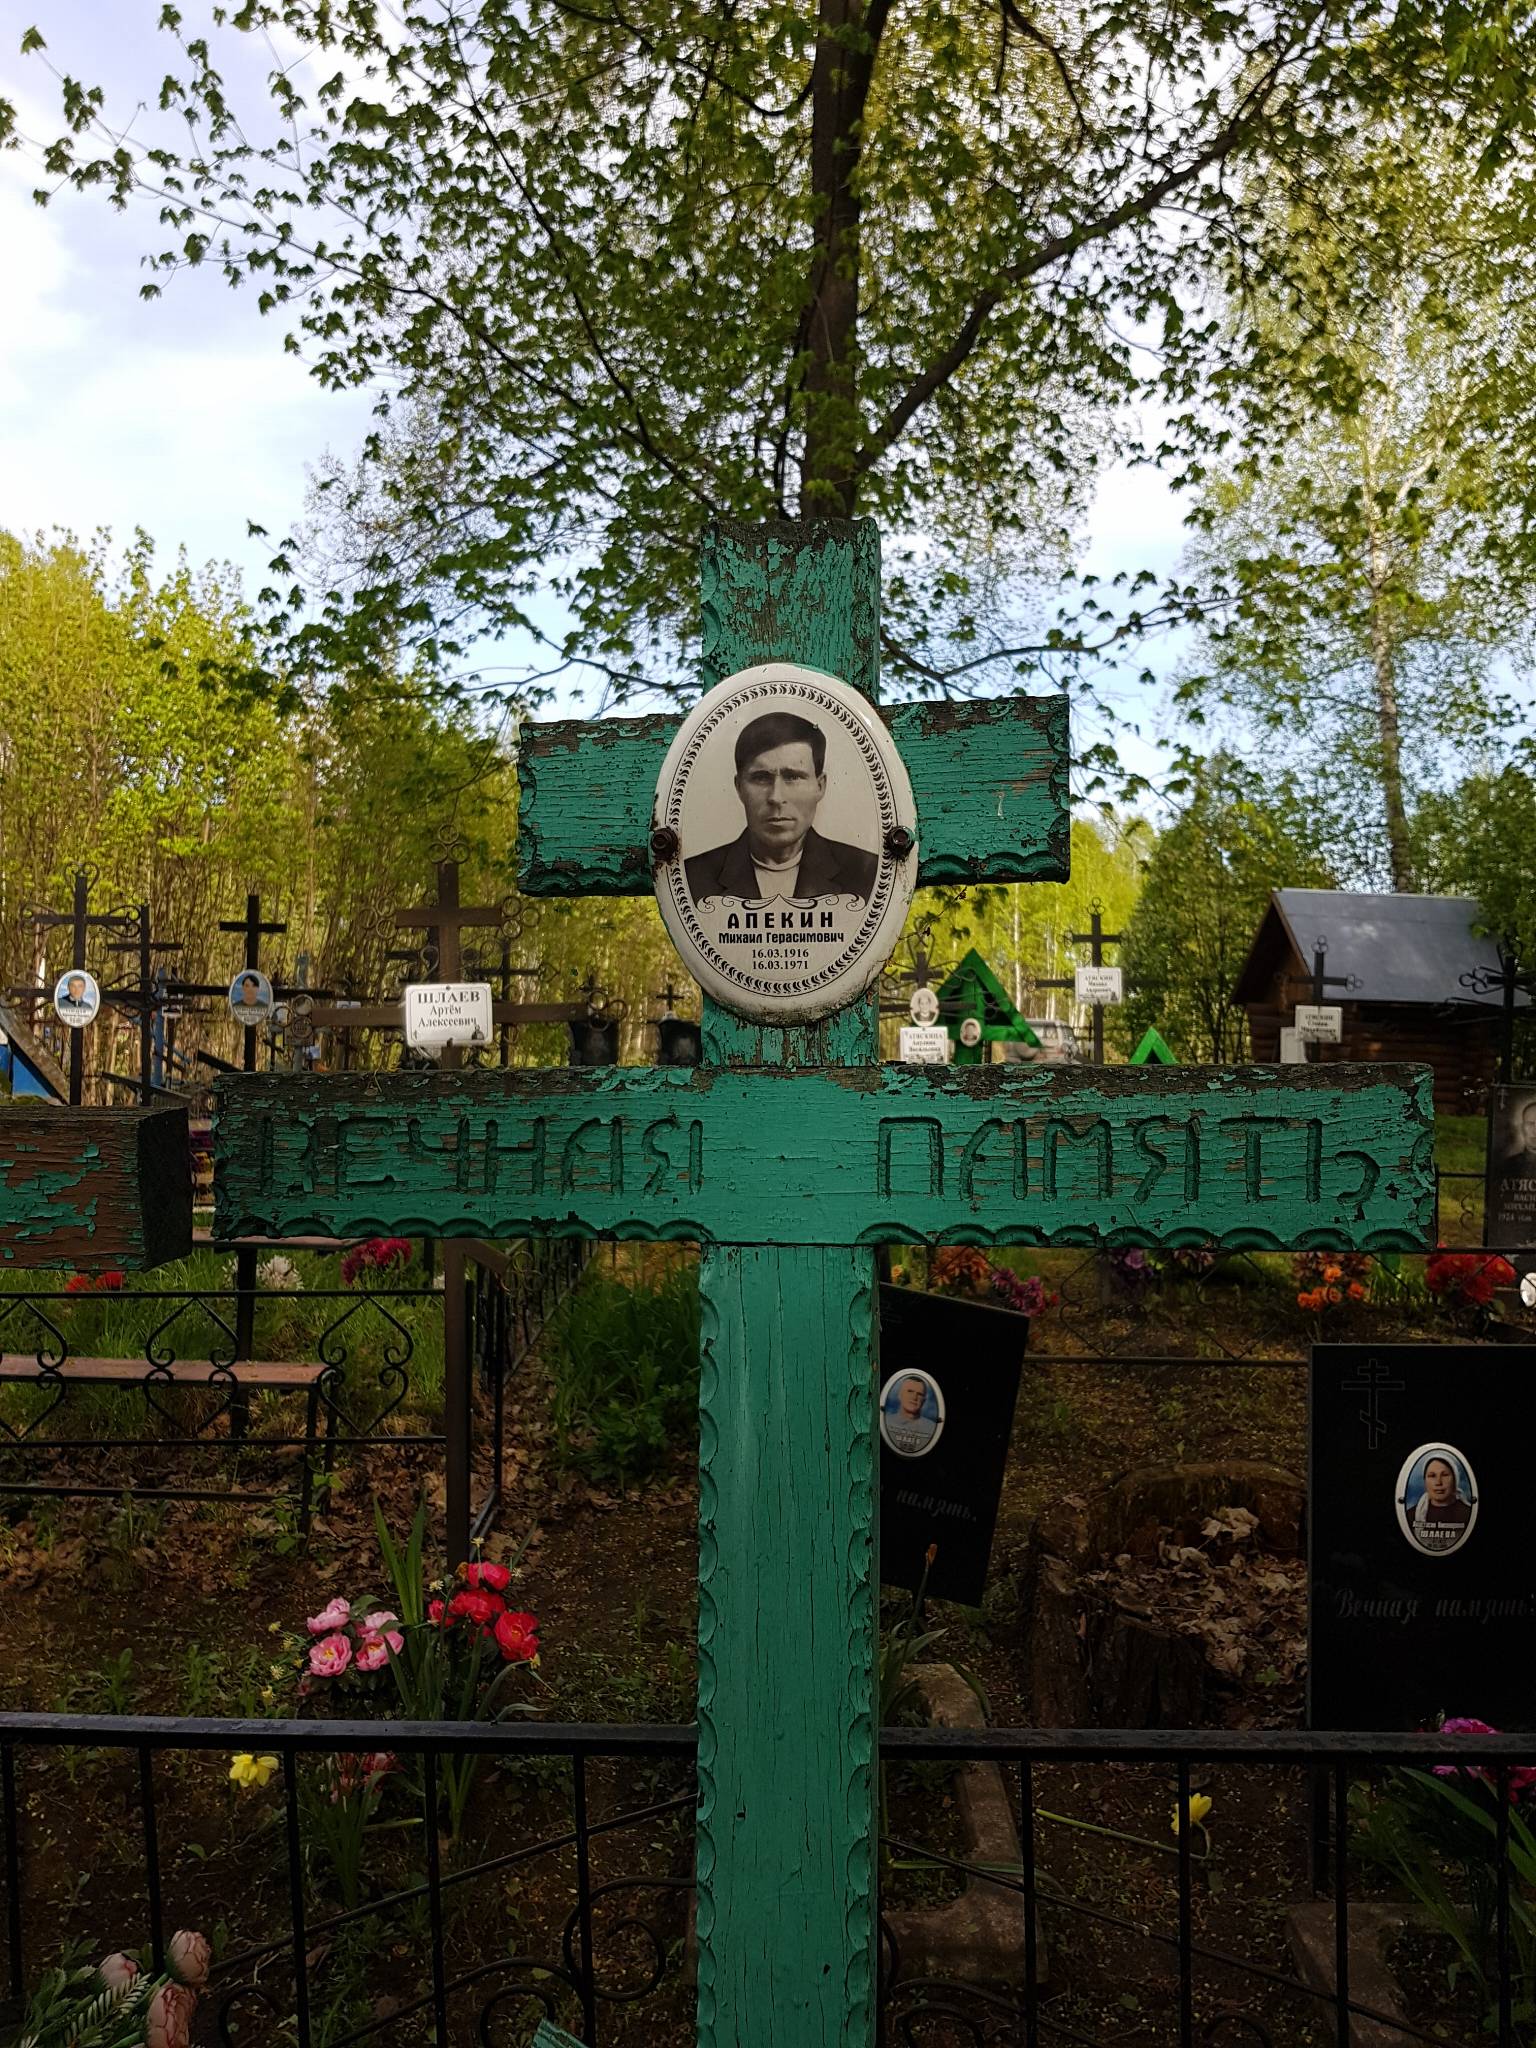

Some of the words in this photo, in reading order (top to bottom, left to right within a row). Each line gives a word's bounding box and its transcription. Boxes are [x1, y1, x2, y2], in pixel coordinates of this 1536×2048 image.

[727, 911, 833, 929] АПЕКИН
[718, 932, 762, 944] Михаил
[766, 931, 845, 944] Герасимович
[752, 948, 809, 959] 16.03.1916
[752, 960, 809, 970] 16.03.1971
[418, 991, 480, 1004] ШЛАЕВ
[430, 1005, 462, 1018] Артём
[418, 1017, 477, 1028] Алексеевич
[261, 1115, 704, 1196] ВЕЧНАЯ
[880, 1114, 1381, 1204] ПАМЯТЬ
